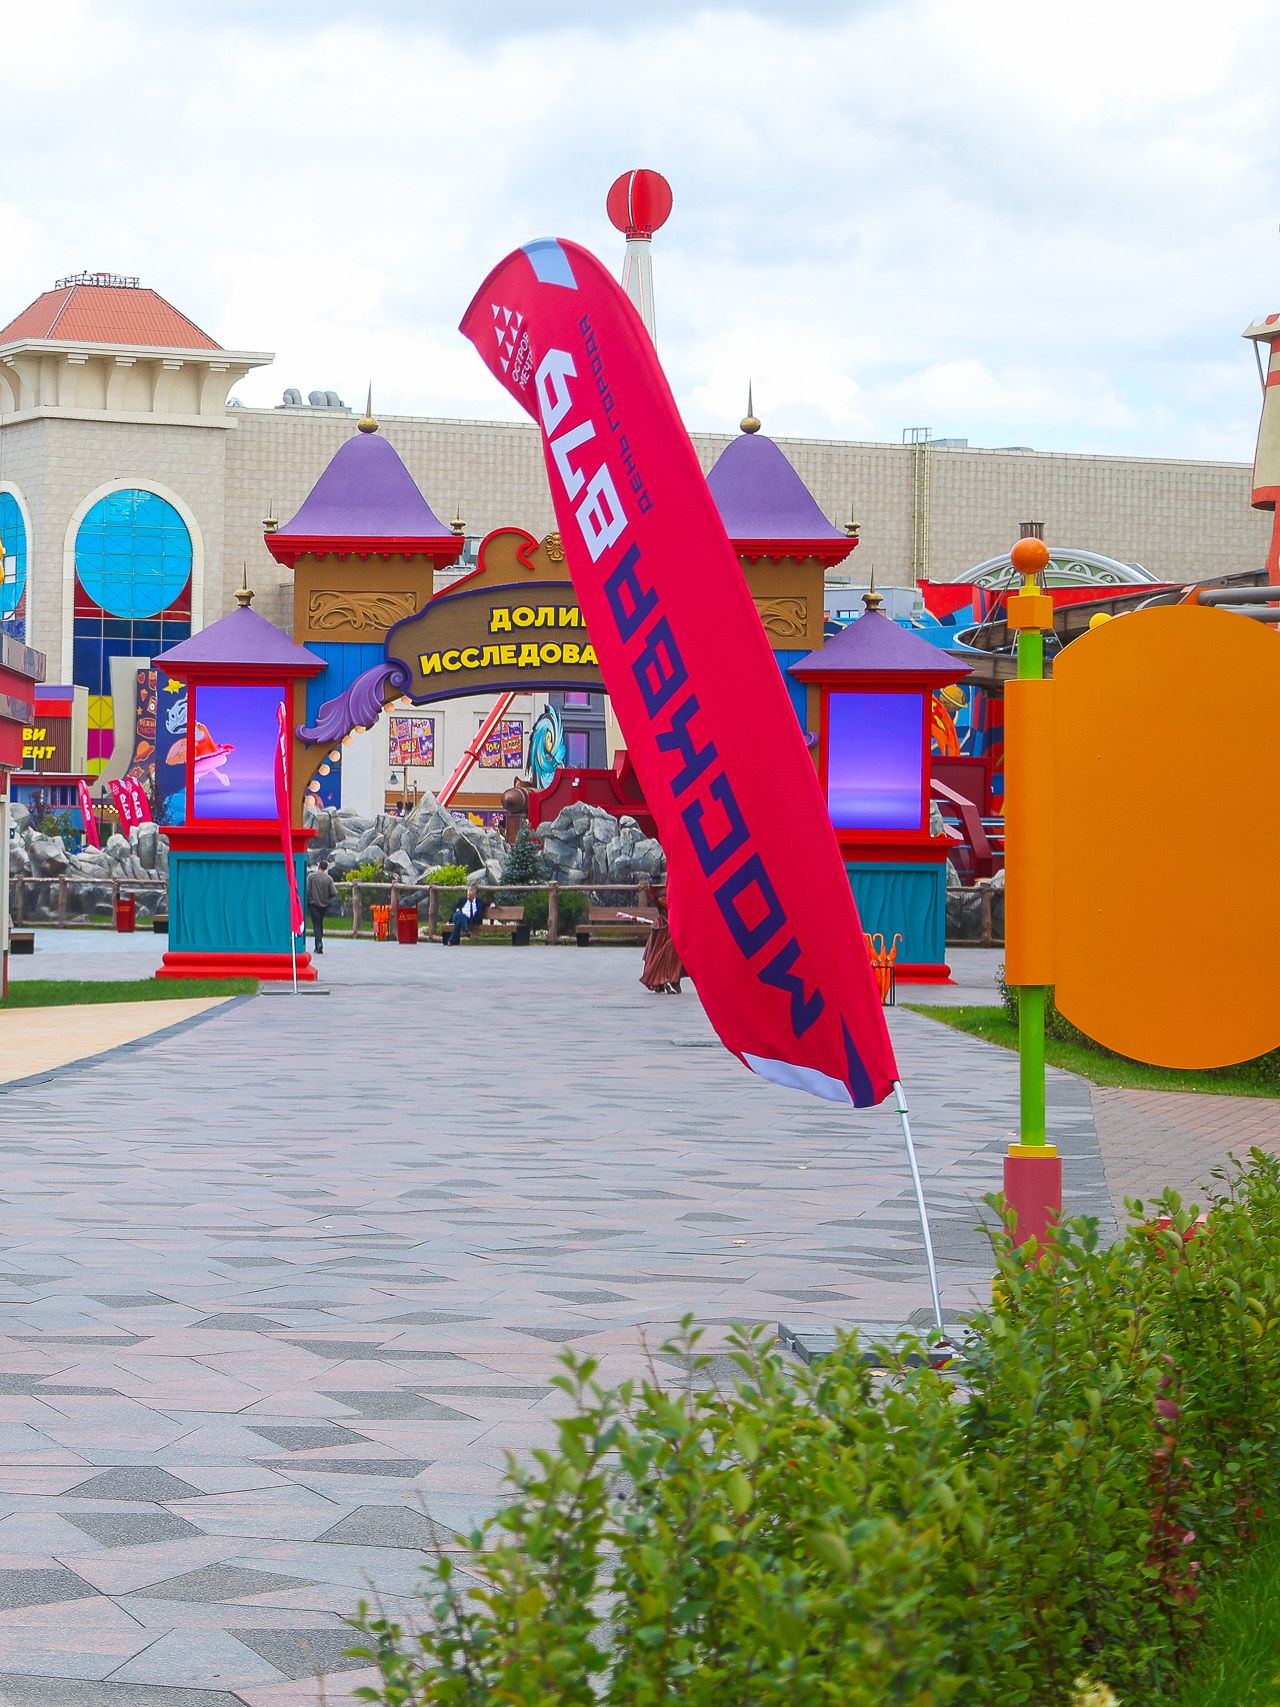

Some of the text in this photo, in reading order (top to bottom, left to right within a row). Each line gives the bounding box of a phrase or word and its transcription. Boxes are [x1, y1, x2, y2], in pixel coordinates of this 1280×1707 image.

[579, 314, 653, 514] ДЕНЬ ГОРОДА
[490, 607, 588, 632] ДОЛИ
[420, 643, 599, 675] ИССЛЕДОВА
[534, 348, 825, 1039] МОСКВА 879
[22, 727, 47, 741] ВИ
[22, 746, 56, 759] ЕНТ
